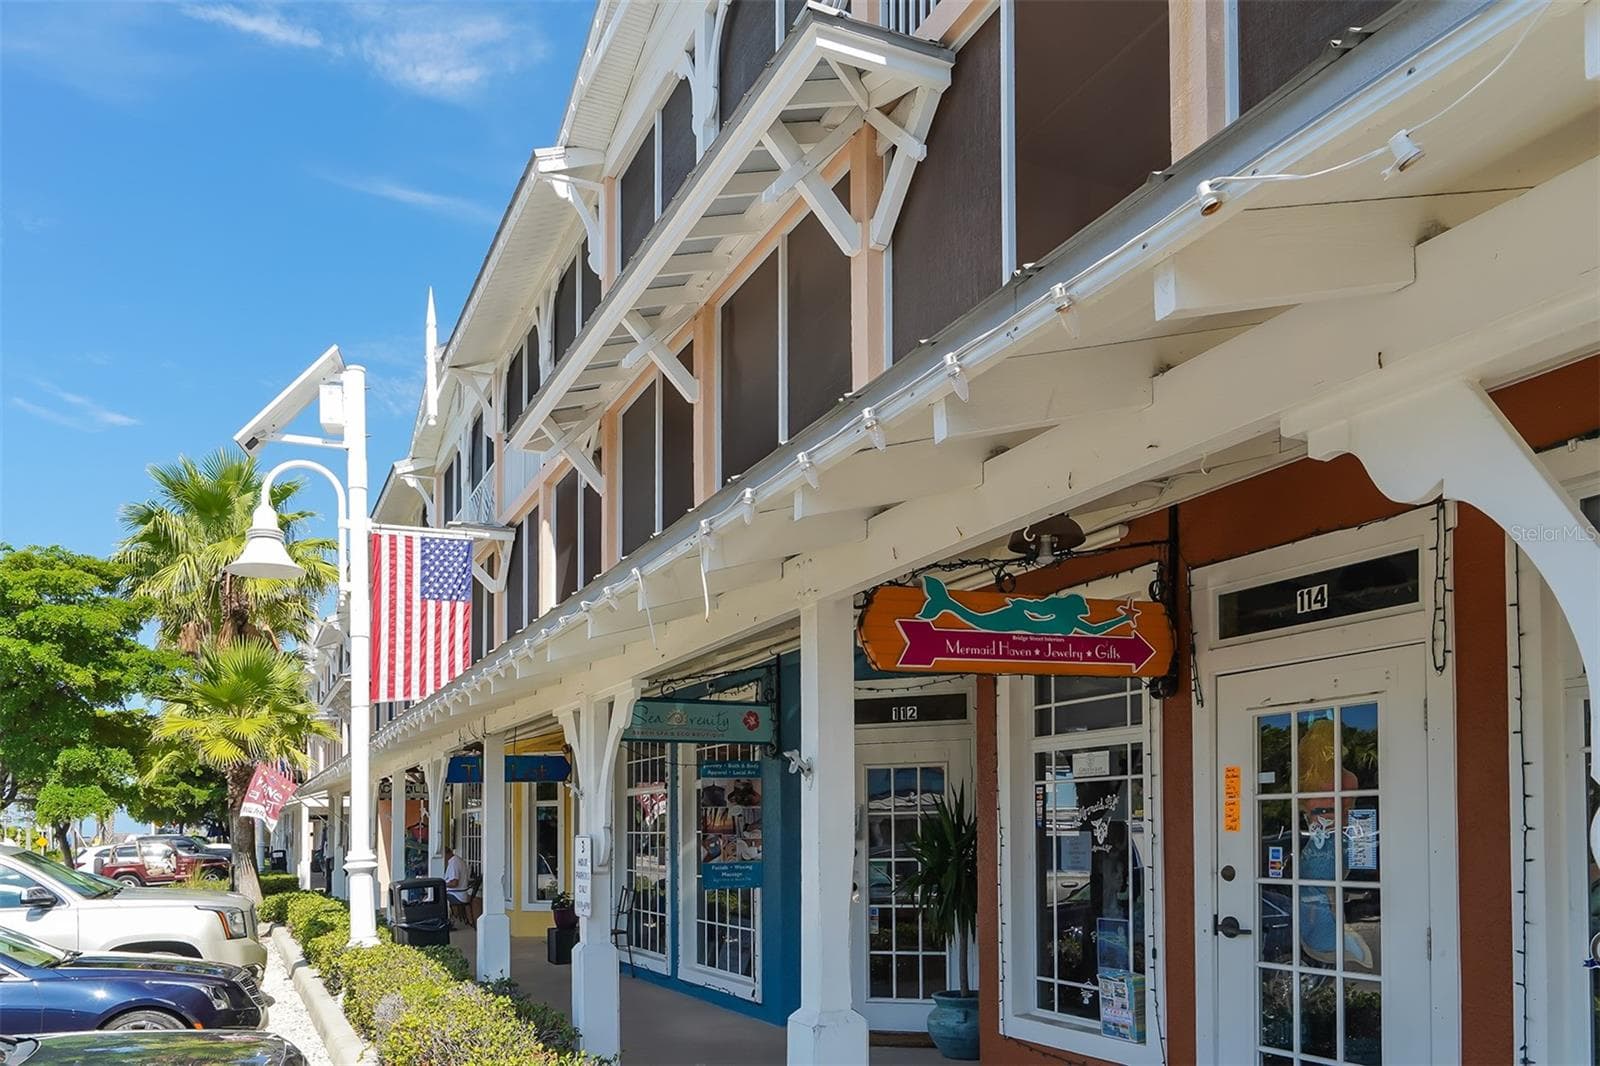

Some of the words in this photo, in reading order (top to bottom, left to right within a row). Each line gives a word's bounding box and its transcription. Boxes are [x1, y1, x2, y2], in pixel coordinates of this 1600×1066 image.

[1298, 584, 1327, 613] 114
[945, 639, 996, 656] Mermaid
[998, 640, 1032, 657] Haven
[1043, 642, 1083, 661] Jewelry
[1095, 643, 1121, 660] Gifts
[892, 706, 917, 720] 112
